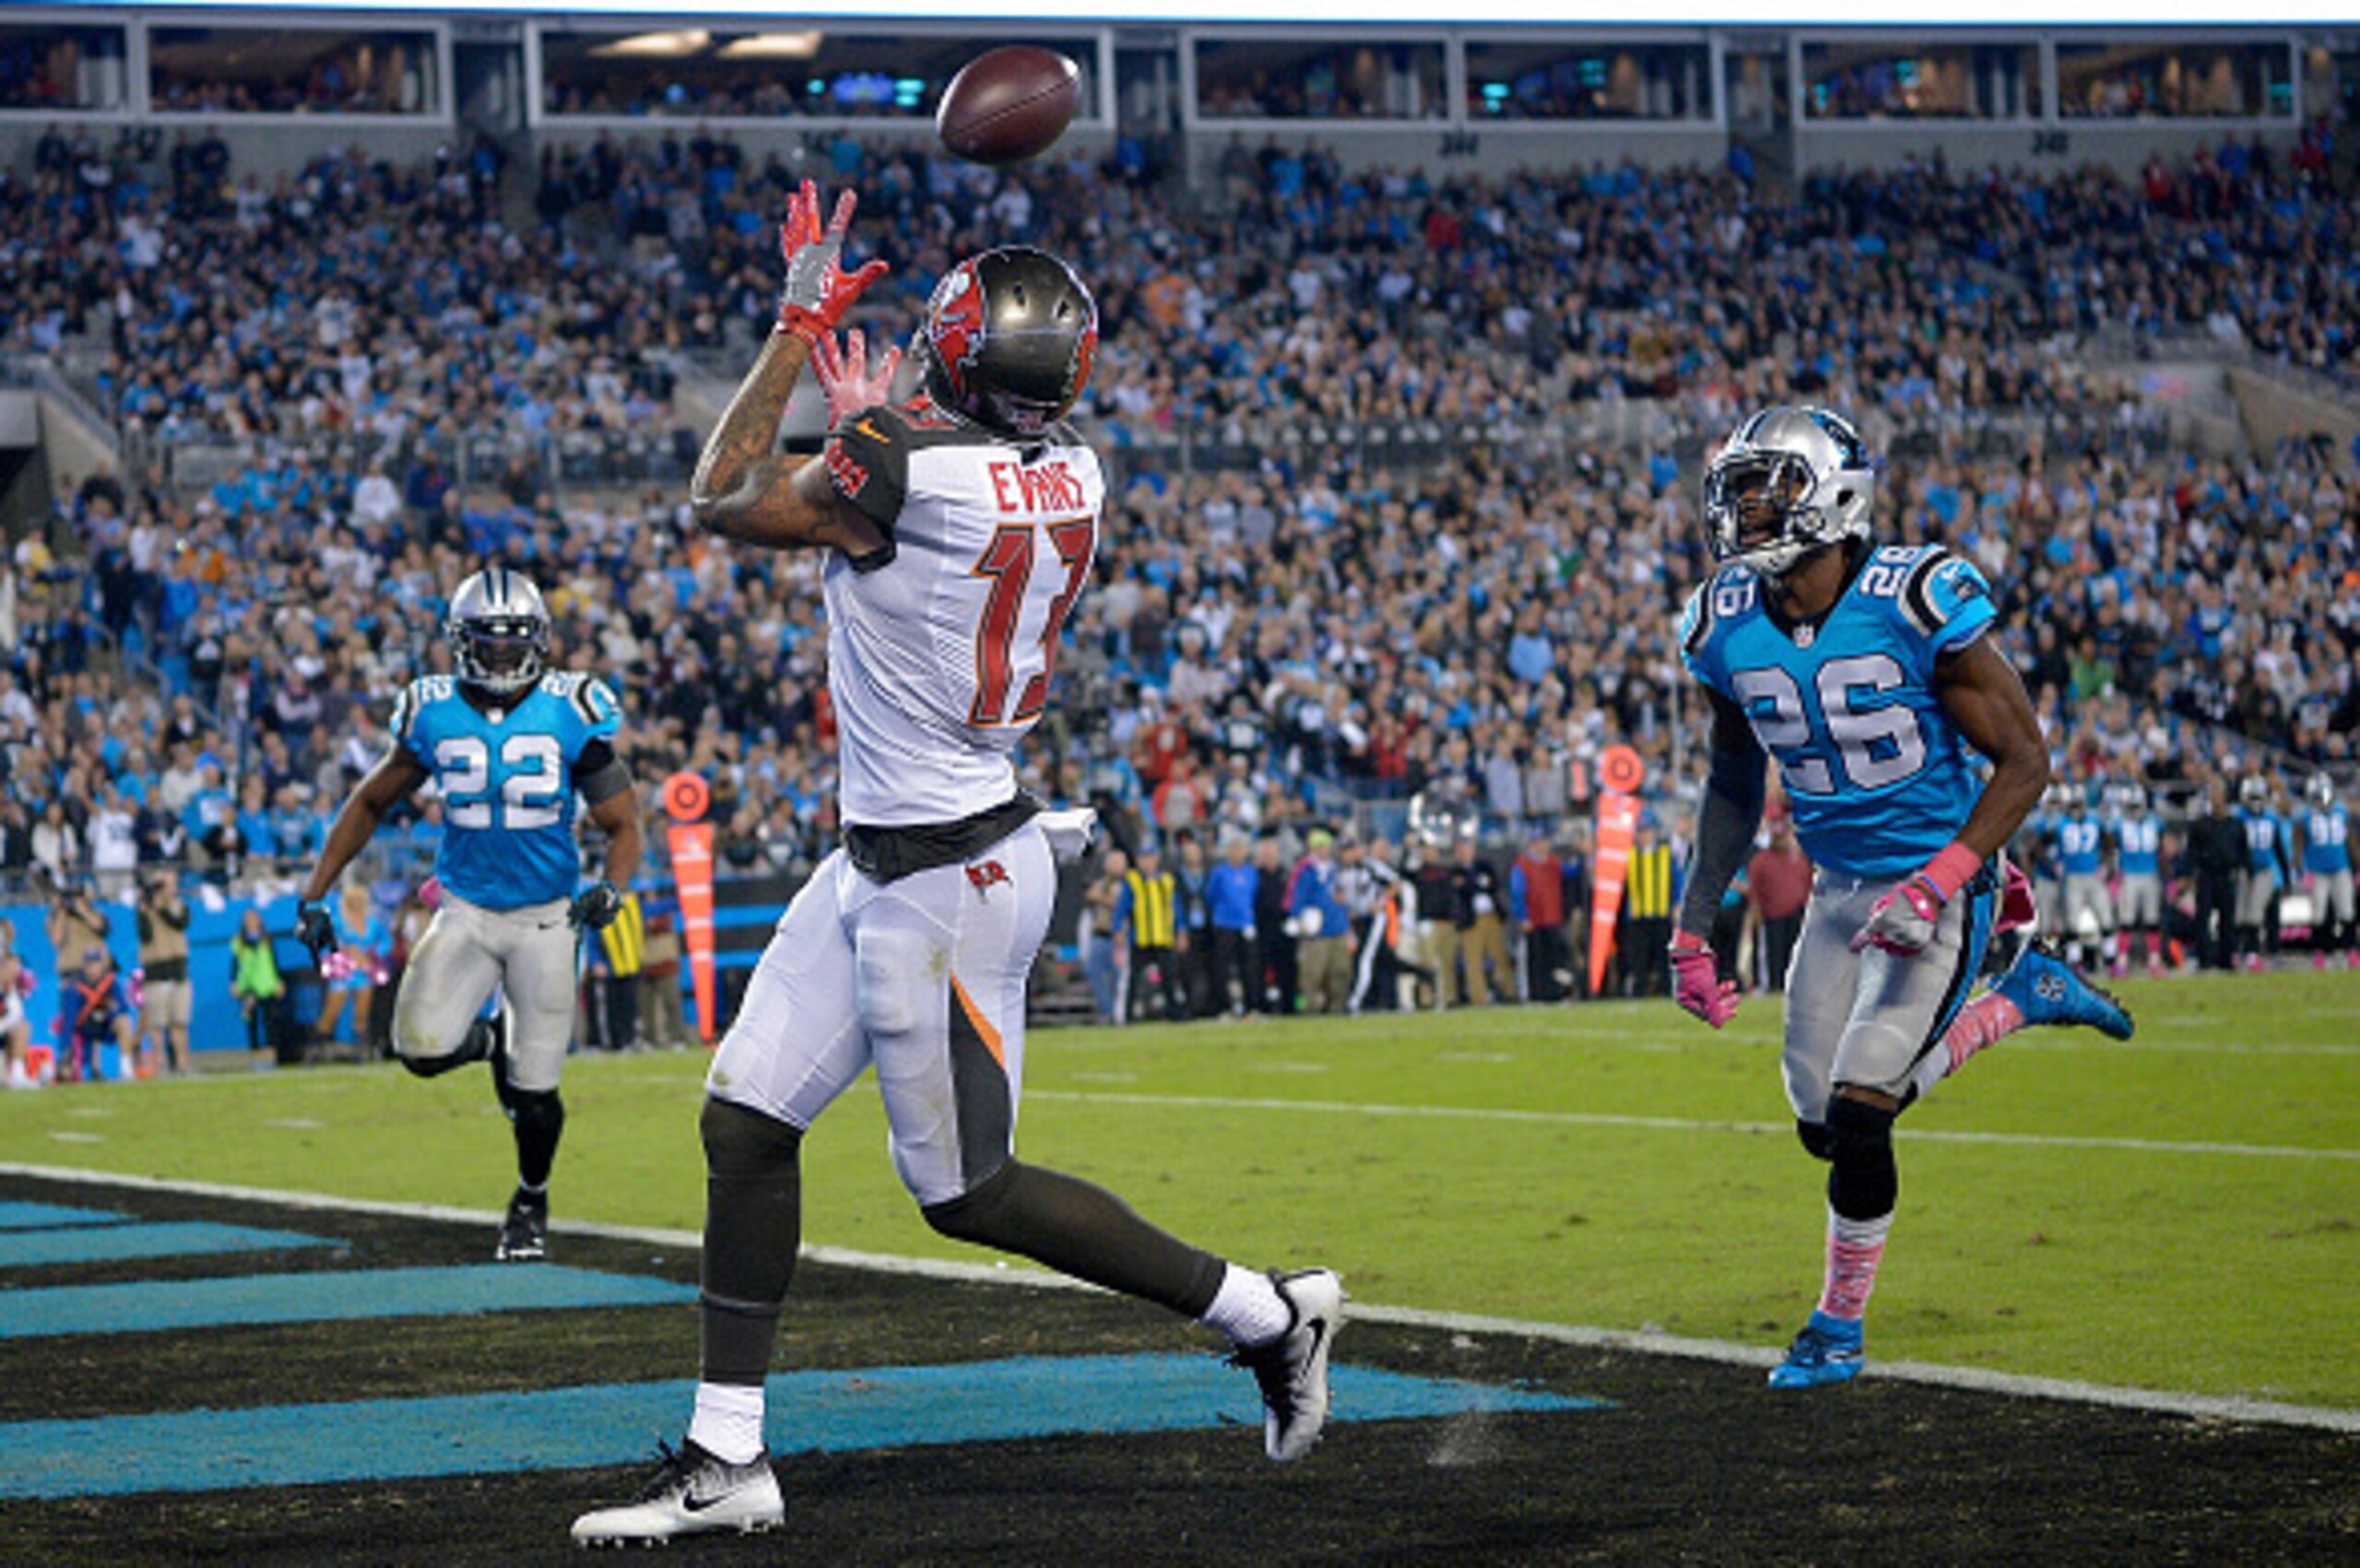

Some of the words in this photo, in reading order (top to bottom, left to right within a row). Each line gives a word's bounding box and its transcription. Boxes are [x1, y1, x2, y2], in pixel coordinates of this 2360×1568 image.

[988, 462, 1086, 513] EVANS
[1731, 653, 1928, 796] 26
[434, 734, 565, 831] 22
